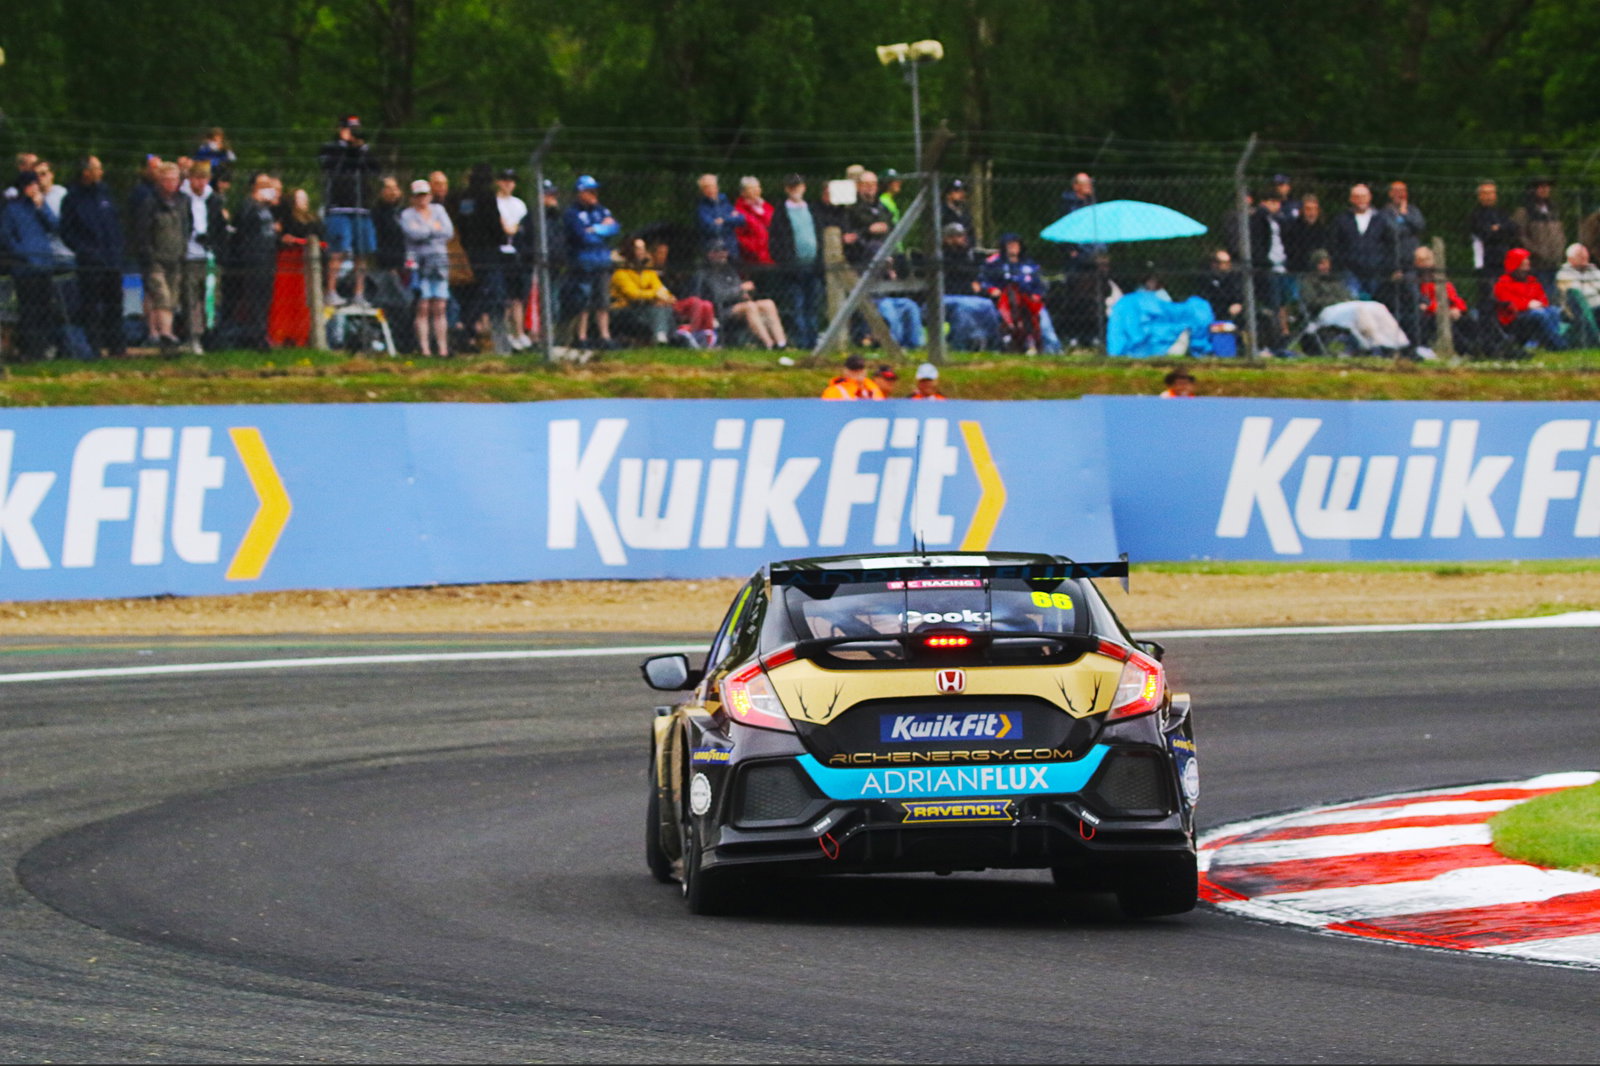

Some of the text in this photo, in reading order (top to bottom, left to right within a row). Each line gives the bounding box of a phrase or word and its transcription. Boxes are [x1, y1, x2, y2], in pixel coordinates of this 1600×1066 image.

[922, 579, 974, 588] RACING
[1030, 591, 1074, 610] 66
[829, 748, 1073, 765] RICHENERGY.COM
[913, 803, 1001, 817] RAVENOL
